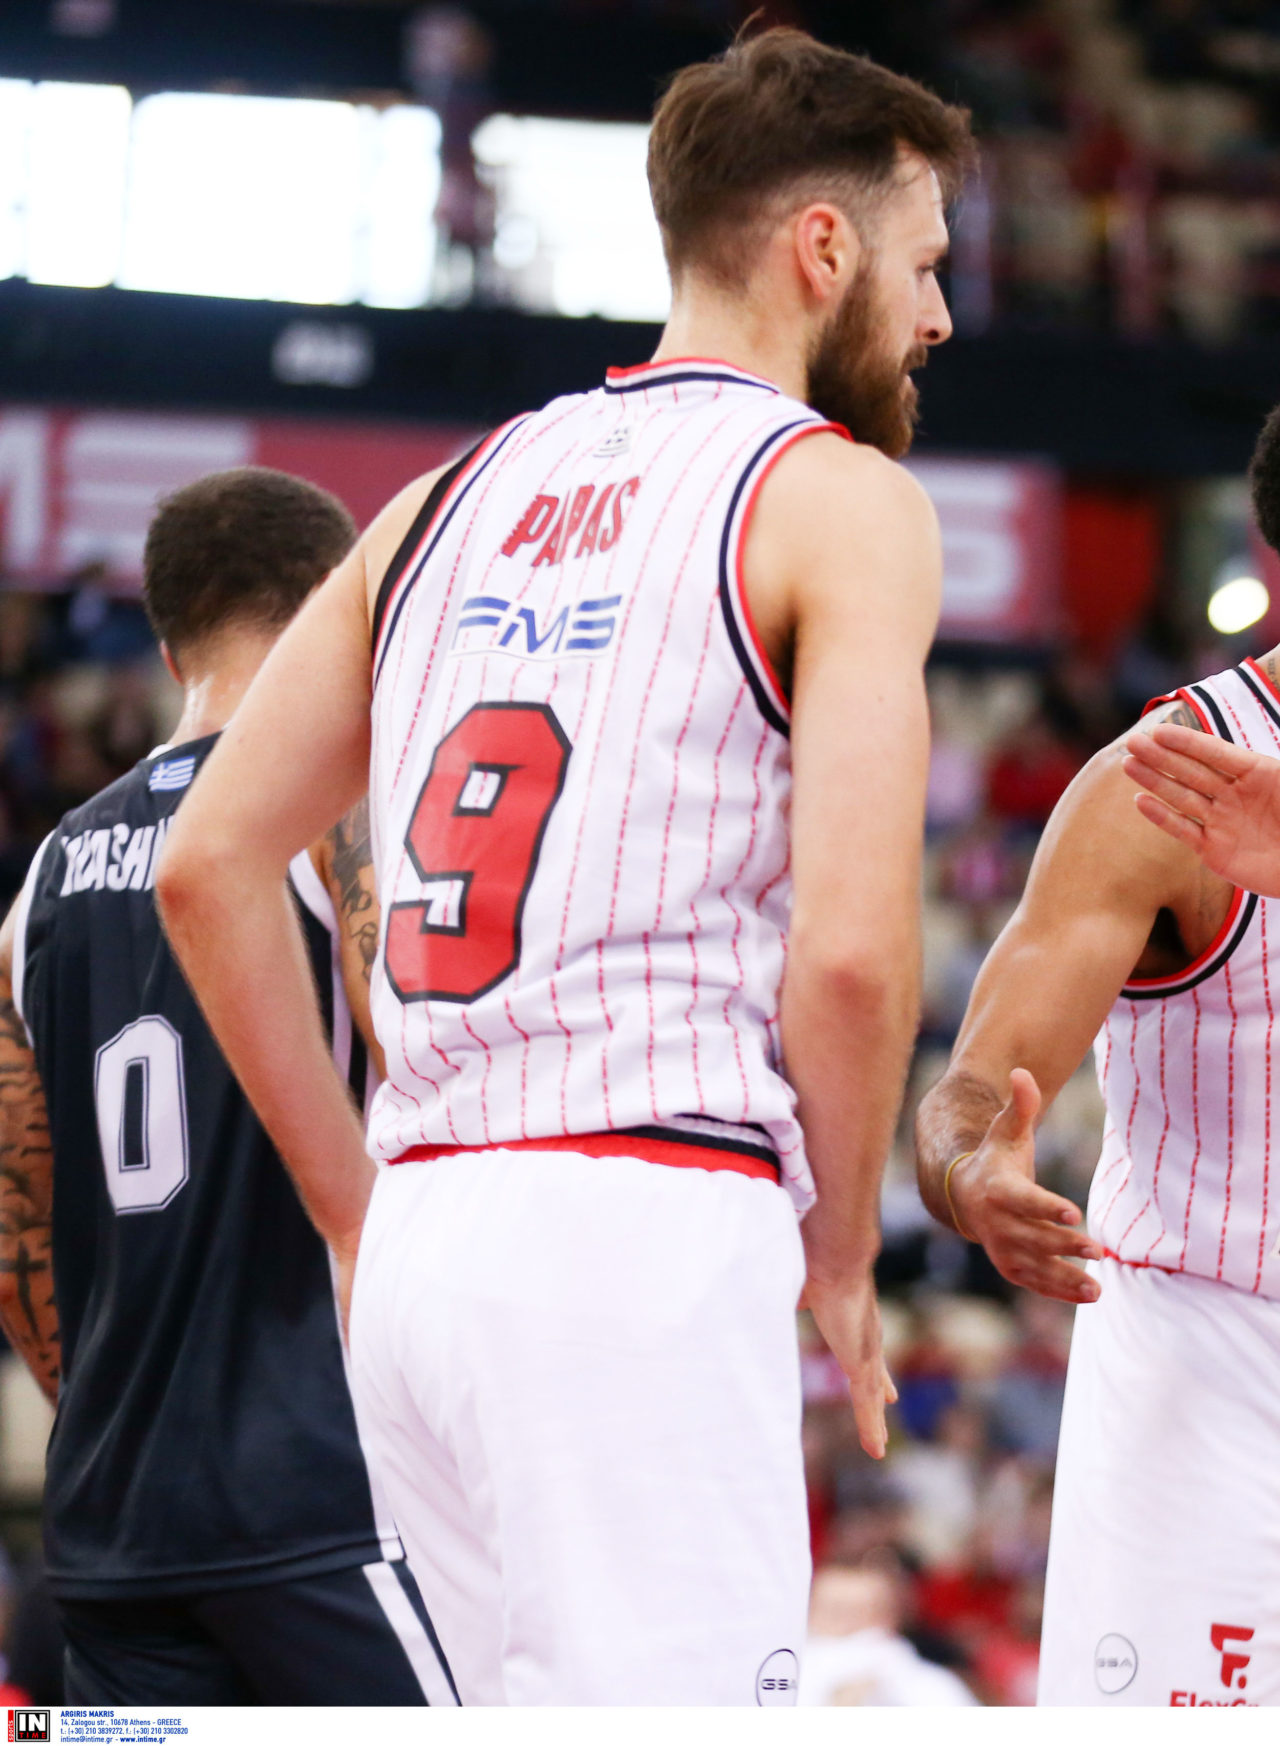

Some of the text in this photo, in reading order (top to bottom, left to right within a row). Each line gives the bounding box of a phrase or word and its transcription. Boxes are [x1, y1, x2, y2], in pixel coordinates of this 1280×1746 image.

[501, 476, 640, 567] PAPAS
[452, 595, 622, 653] FMS
[383, 701, 573, 1005] 9
[94, 1013, 190, 1216] 0
